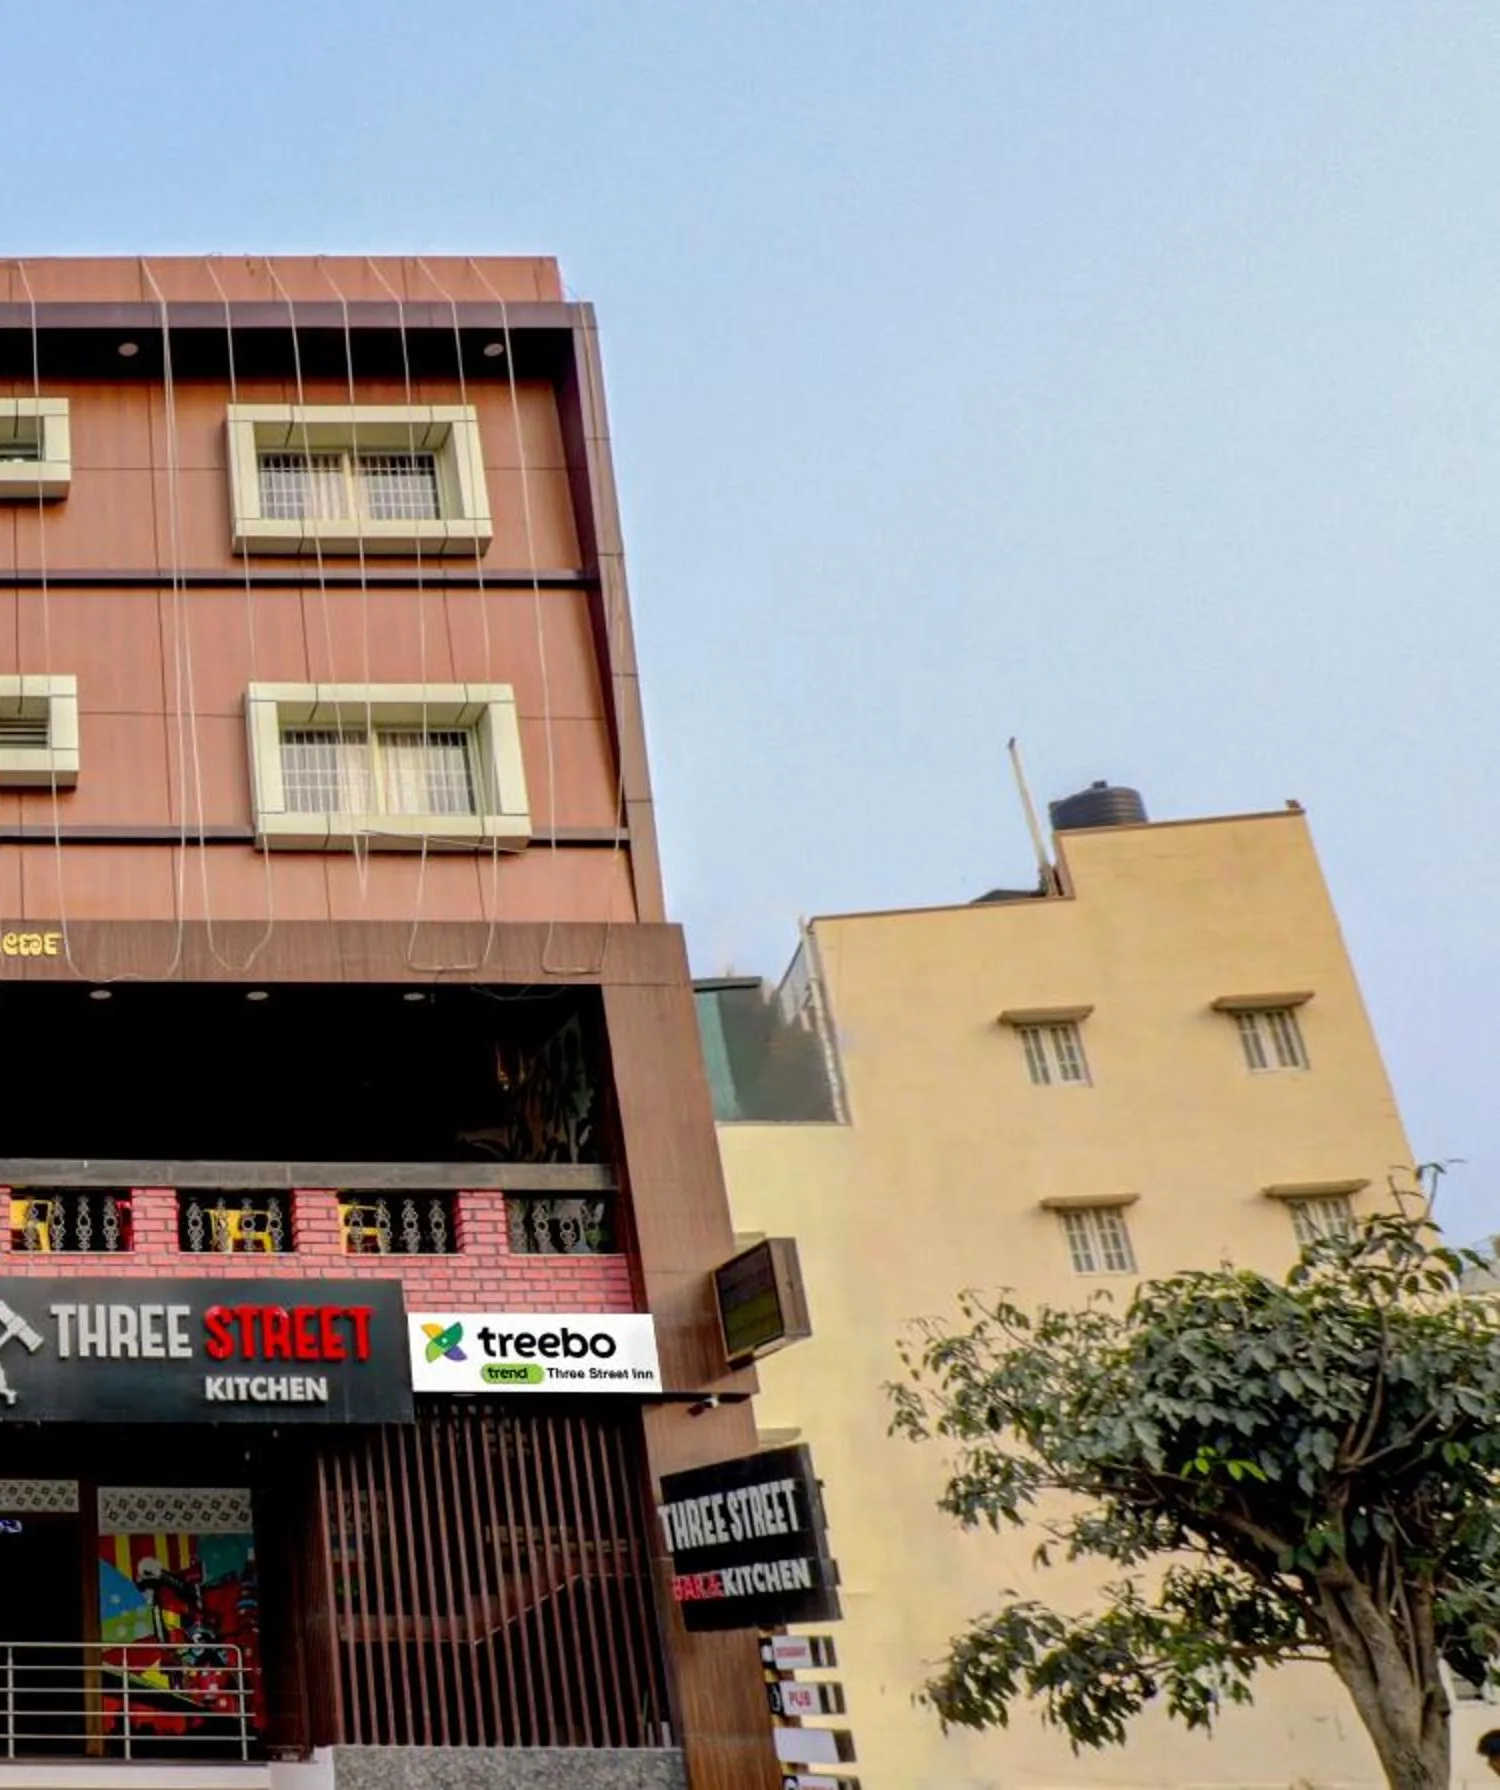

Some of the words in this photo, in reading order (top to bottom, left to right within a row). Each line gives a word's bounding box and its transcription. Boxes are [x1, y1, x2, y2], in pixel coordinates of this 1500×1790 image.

[49, 1304, 194, 1359] THREE
[204, 1304, 374, 1361] STREET
[476, 1326, 617, 1359] treebo
[205, 1376, 329, 1401] KITCHEN
[487, 1366, 529, 1380] trend
[546, 1366, 586, 1381] Three
[588, 1366, 630, 1381] Street
[632, 1366, 654, 1381] Inn
[657, 1493, 731, 1553] THREE
[726, 1478, 799, 1542] STREET
[721, 1557, 812, 1597] KITCHEN
